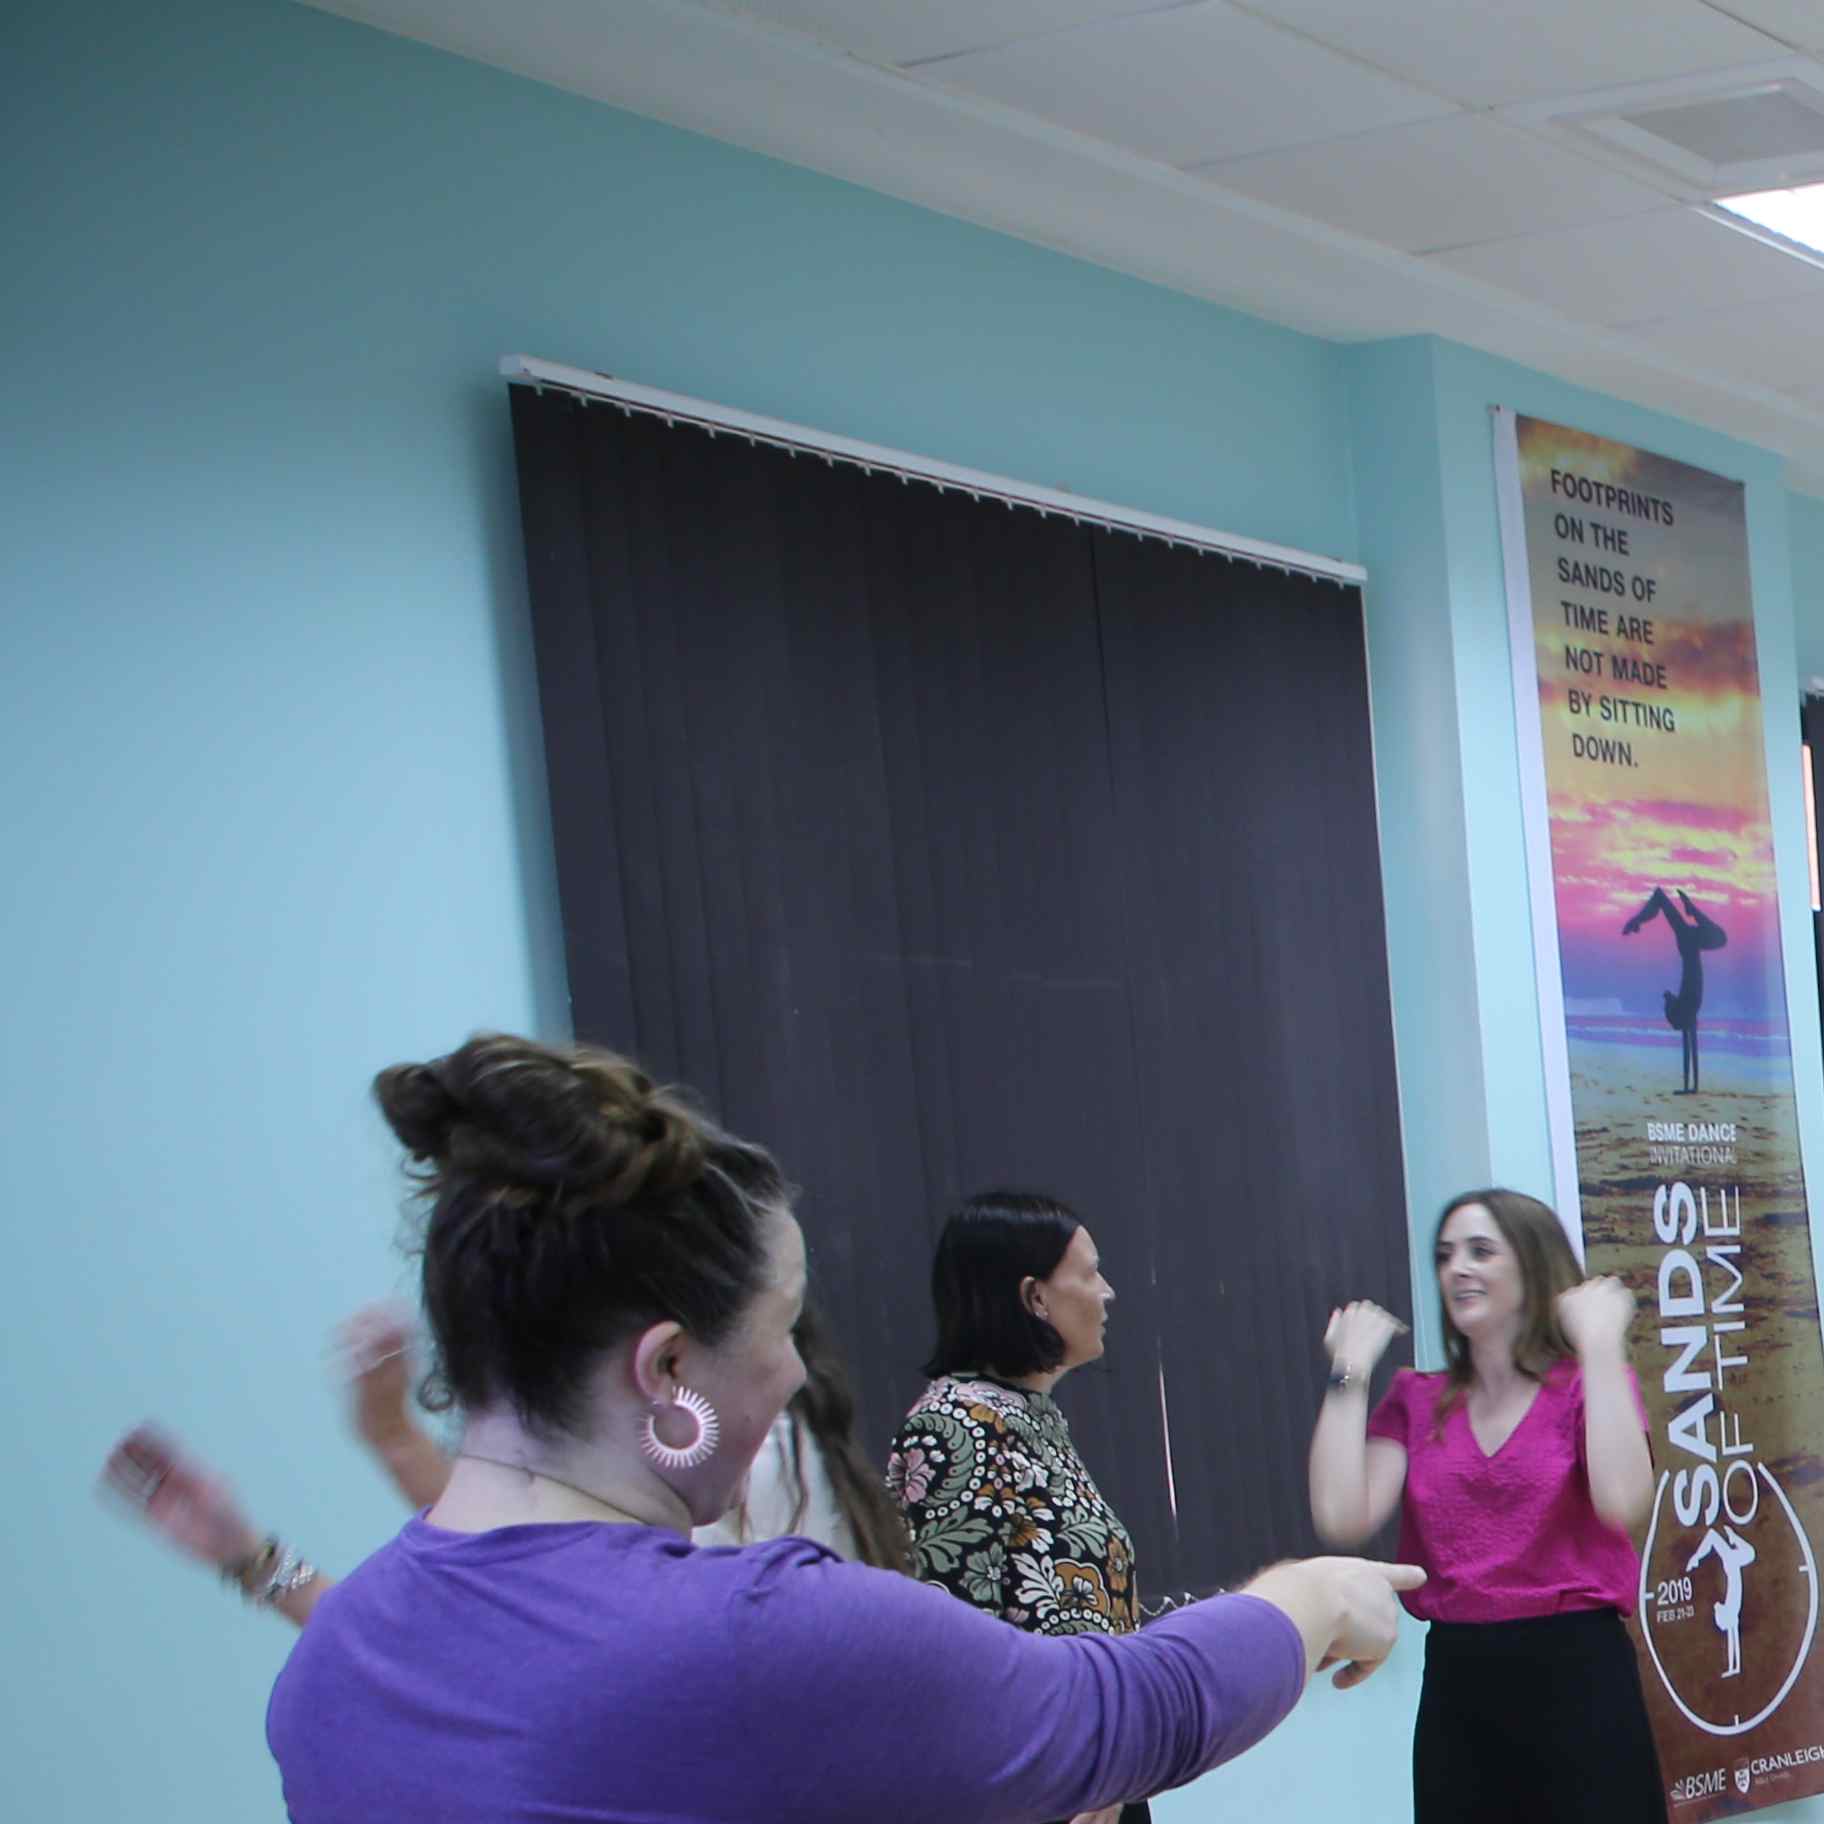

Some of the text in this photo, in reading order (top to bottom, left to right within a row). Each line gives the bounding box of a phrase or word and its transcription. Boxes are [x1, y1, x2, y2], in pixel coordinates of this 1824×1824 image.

[1550, 469, 1674, 526] FOOTPRINTS
[1554, 513, 1629, 556] ON THE
[1557, 557, 1657, 602] SANDS OF
[1561, 600, 1654, 645] TIME ARE
[1565, 645, 1668, 690] NOT MADE
[1568, 688, 1675, 733] BY SITTING
[1571, 732, 1639, 768] DOWN.
[1647, 1122, 1737, 1142] BSME DANCE
[1653, 1180, 1721, 1527] SANDS
[1700, 1186, 1759, 1525] OF TIME
[1657, 1576, 1693, 1606] 2019
[1656, 1609, 1676, 1623] FEB
[1685, 1767, 1727, 1799] BSME
